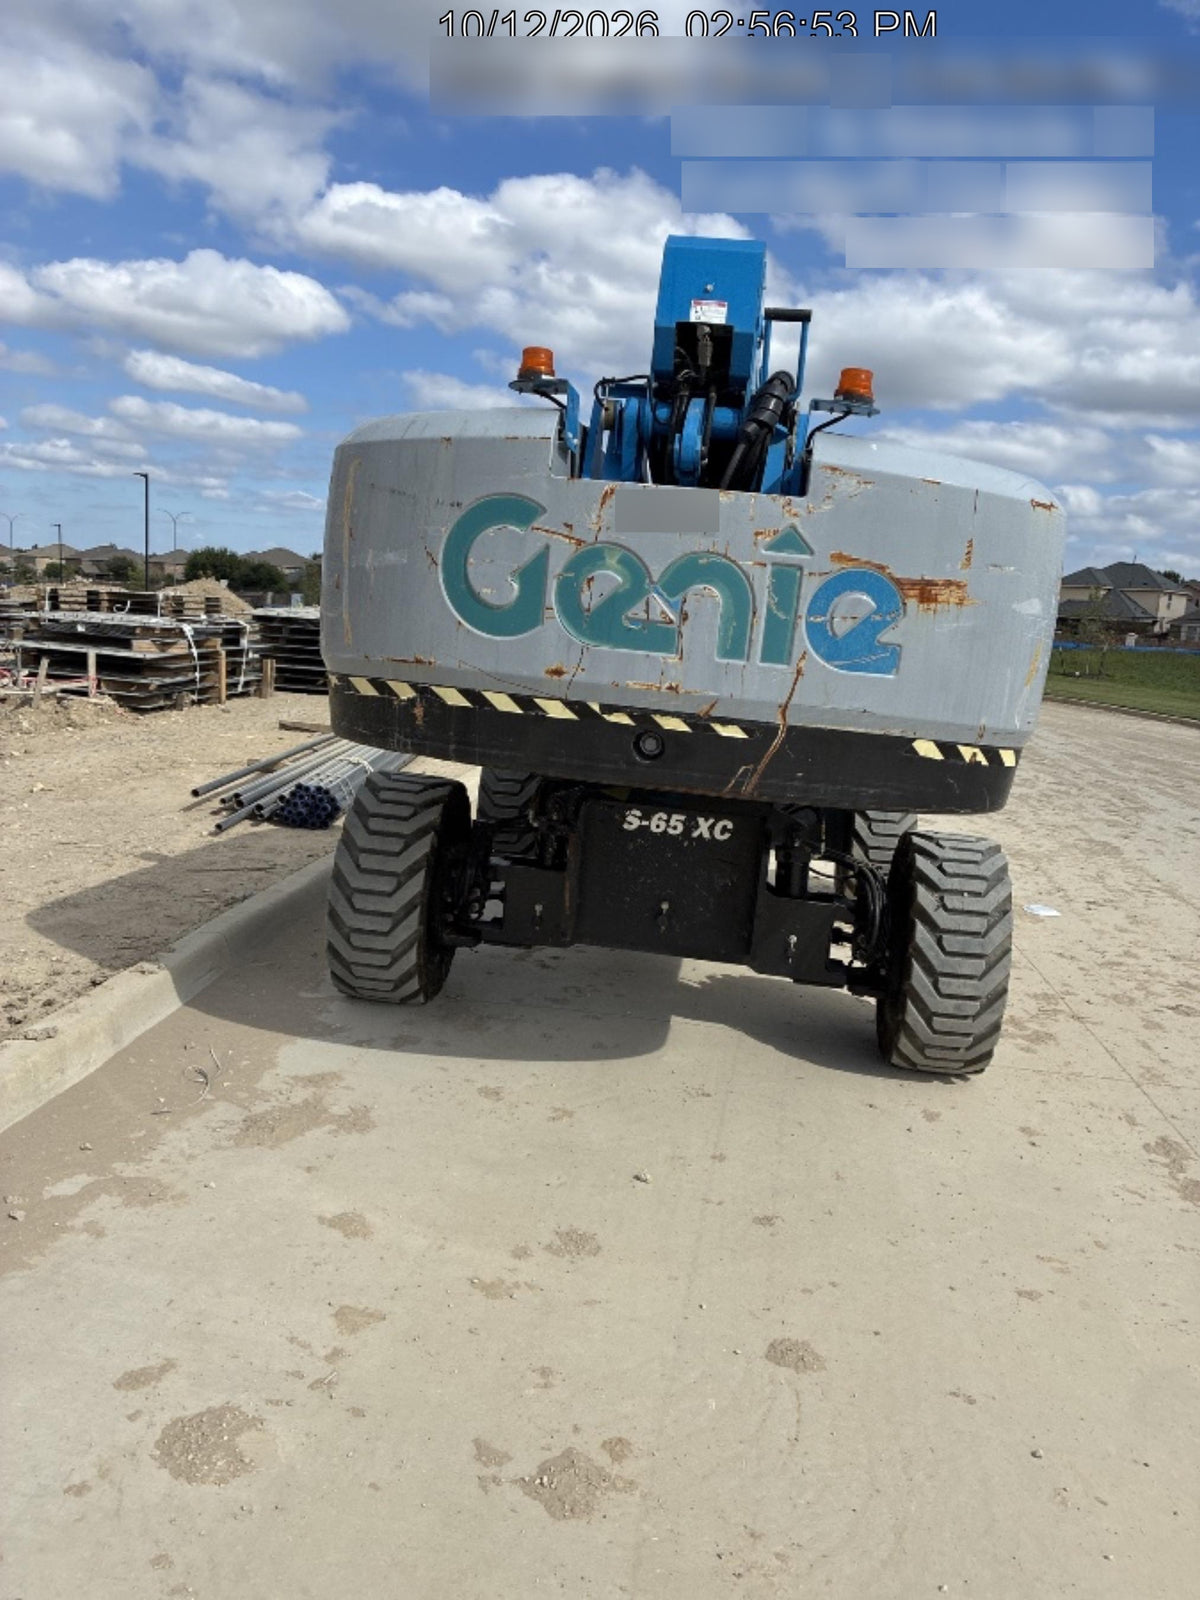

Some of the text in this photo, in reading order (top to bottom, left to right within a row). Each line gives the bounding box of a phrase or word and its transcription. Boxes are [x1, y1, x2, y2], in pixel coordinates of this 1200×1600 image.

[439, 492, 905, 678] Genie
[622, 808, 734, 841] S-65 XC
